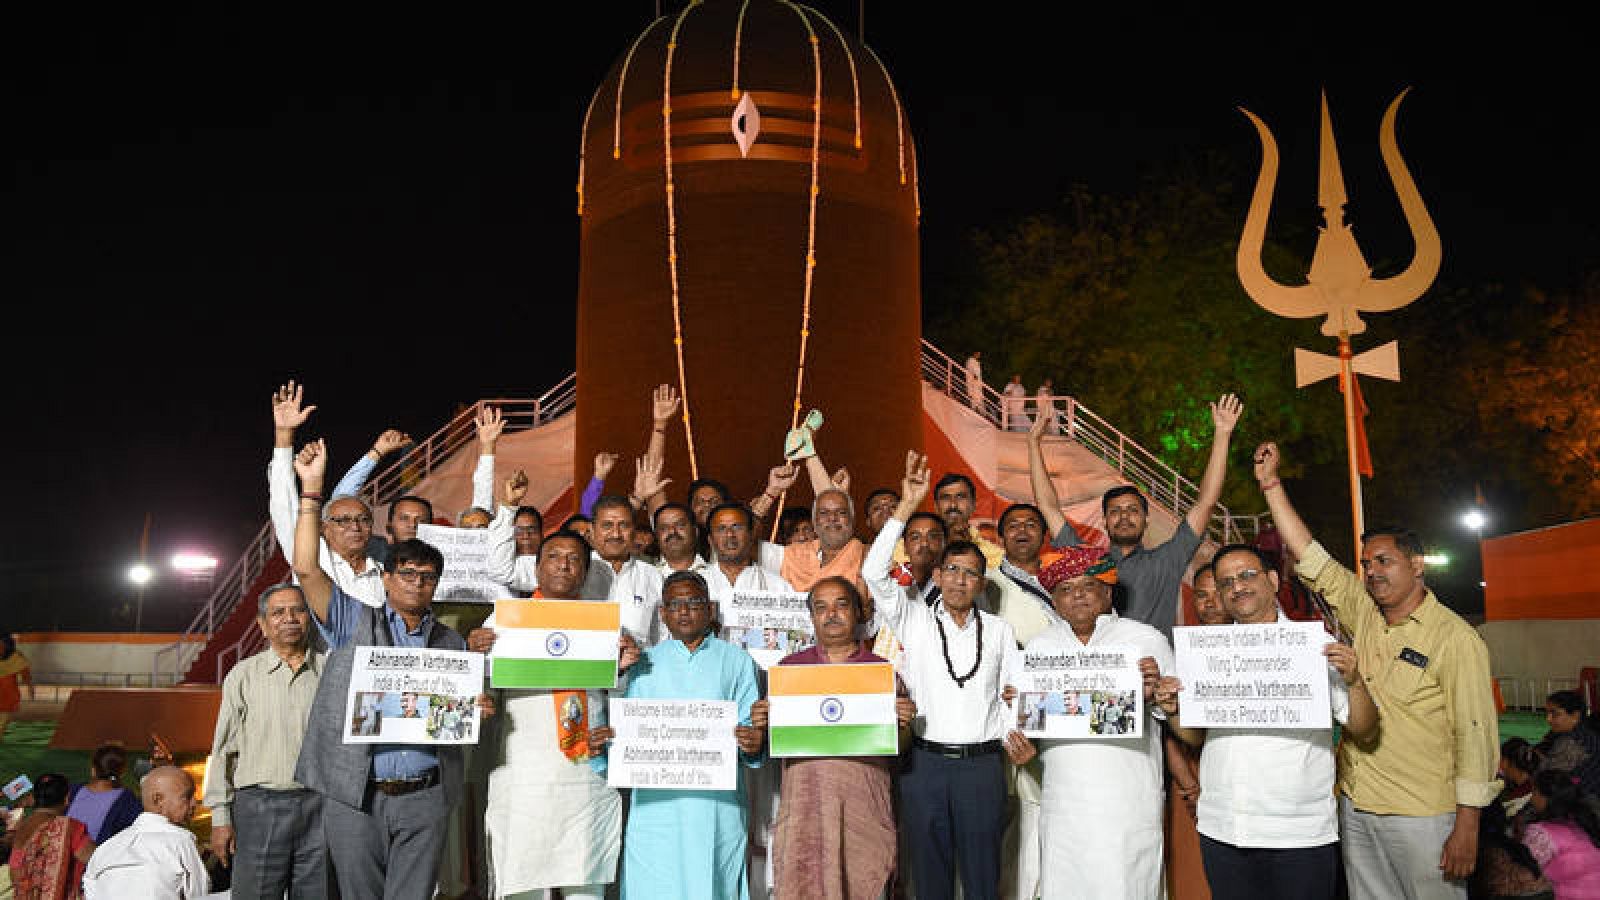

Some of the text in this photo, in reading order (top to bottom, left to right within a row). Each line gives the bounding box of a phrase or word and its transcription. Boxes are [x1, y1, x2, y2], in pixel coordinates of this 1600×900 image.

[1188, 627, 1307, 649] Welcome Indian Air Force
[368, 650, 420, 668] Abhinandan
[1023, 650, 1076, 668] Abhinandan
[1205, 655, 1231, 676] Wing
[373, 674, 393, 690] India
[403, 674, 429, 691] Proud
[1033, 674, 1053, 691] India
[1063, 673, 1089, 690] Proud
[1193, 679, 1253, 697] Abhinandan
[623, 702, 660, 718] Welcome
[701, 703, 724, 718] Force
[1204, 704, 1227, 722] India
[1229, 704, 1237, 722] is
[1239, 704, 1267, 722] Proud
[1269, 704, 1280, 722] of
[624, 746, 675, 761] Abhinandan
